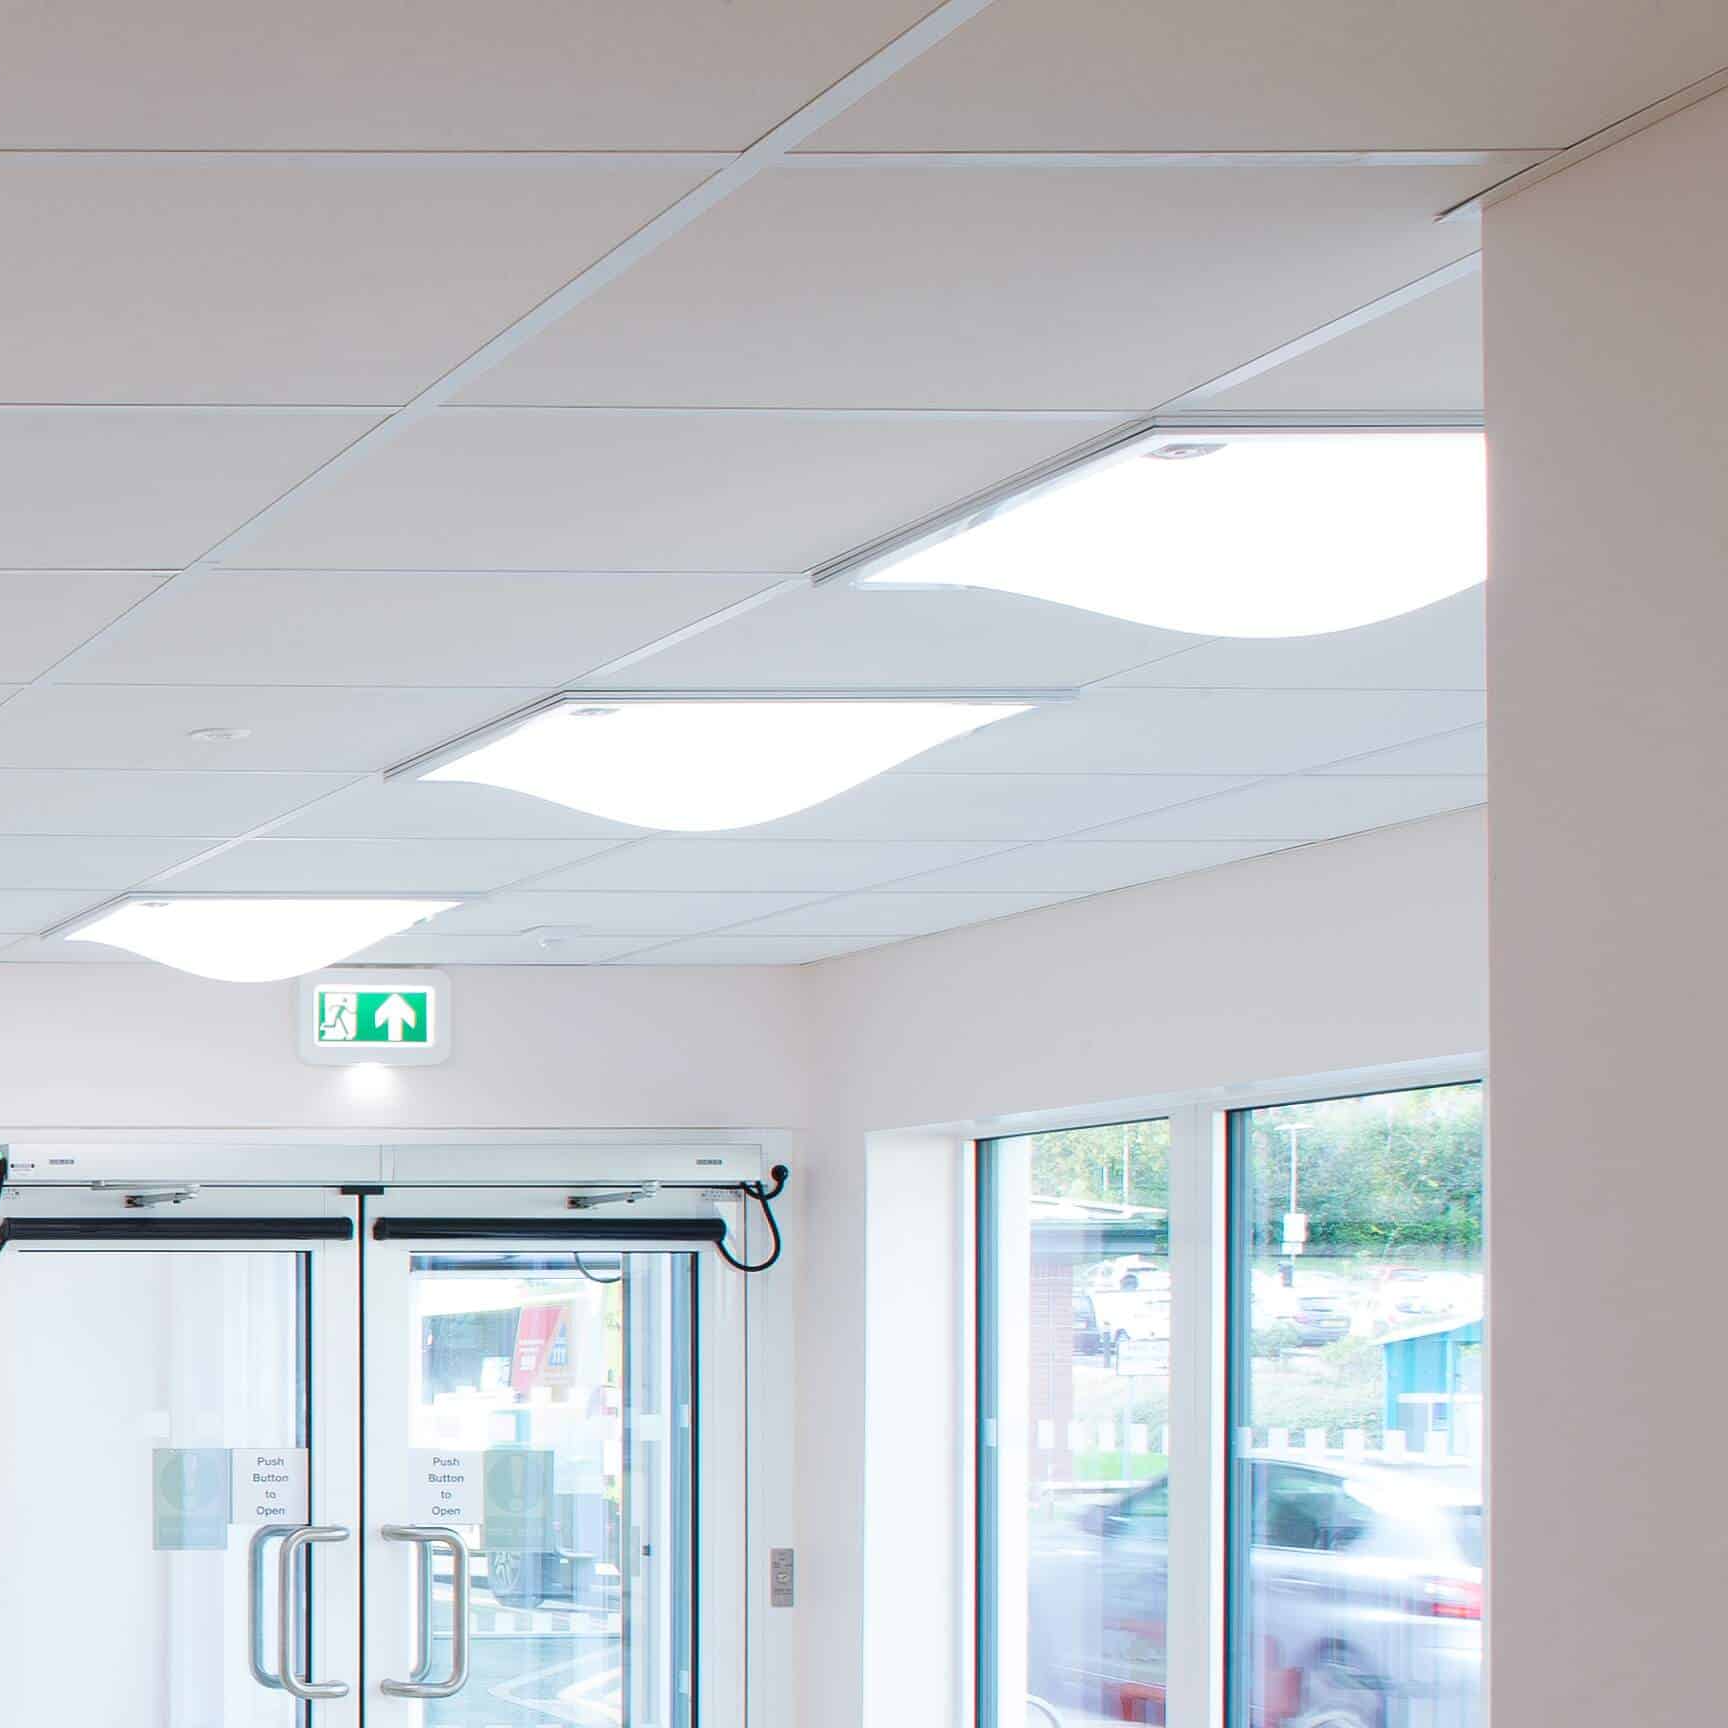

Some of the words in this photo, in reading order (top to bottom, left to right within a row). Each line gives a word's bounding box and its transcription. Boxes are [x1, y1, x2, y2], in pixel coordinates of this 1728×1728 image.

[256, 1457, 285, 1467] Push
[432, 1457, 461, 1467] Push
[252, 1473, 289, 1483] Button
[427, 1473, 464, 1483] Button
[265, 1490, 277, 1499] to
[440, 1490, 452, 1500] to
[255, 1506, 286, 1517] Open
[431, 1506, 461, 1517] Open
